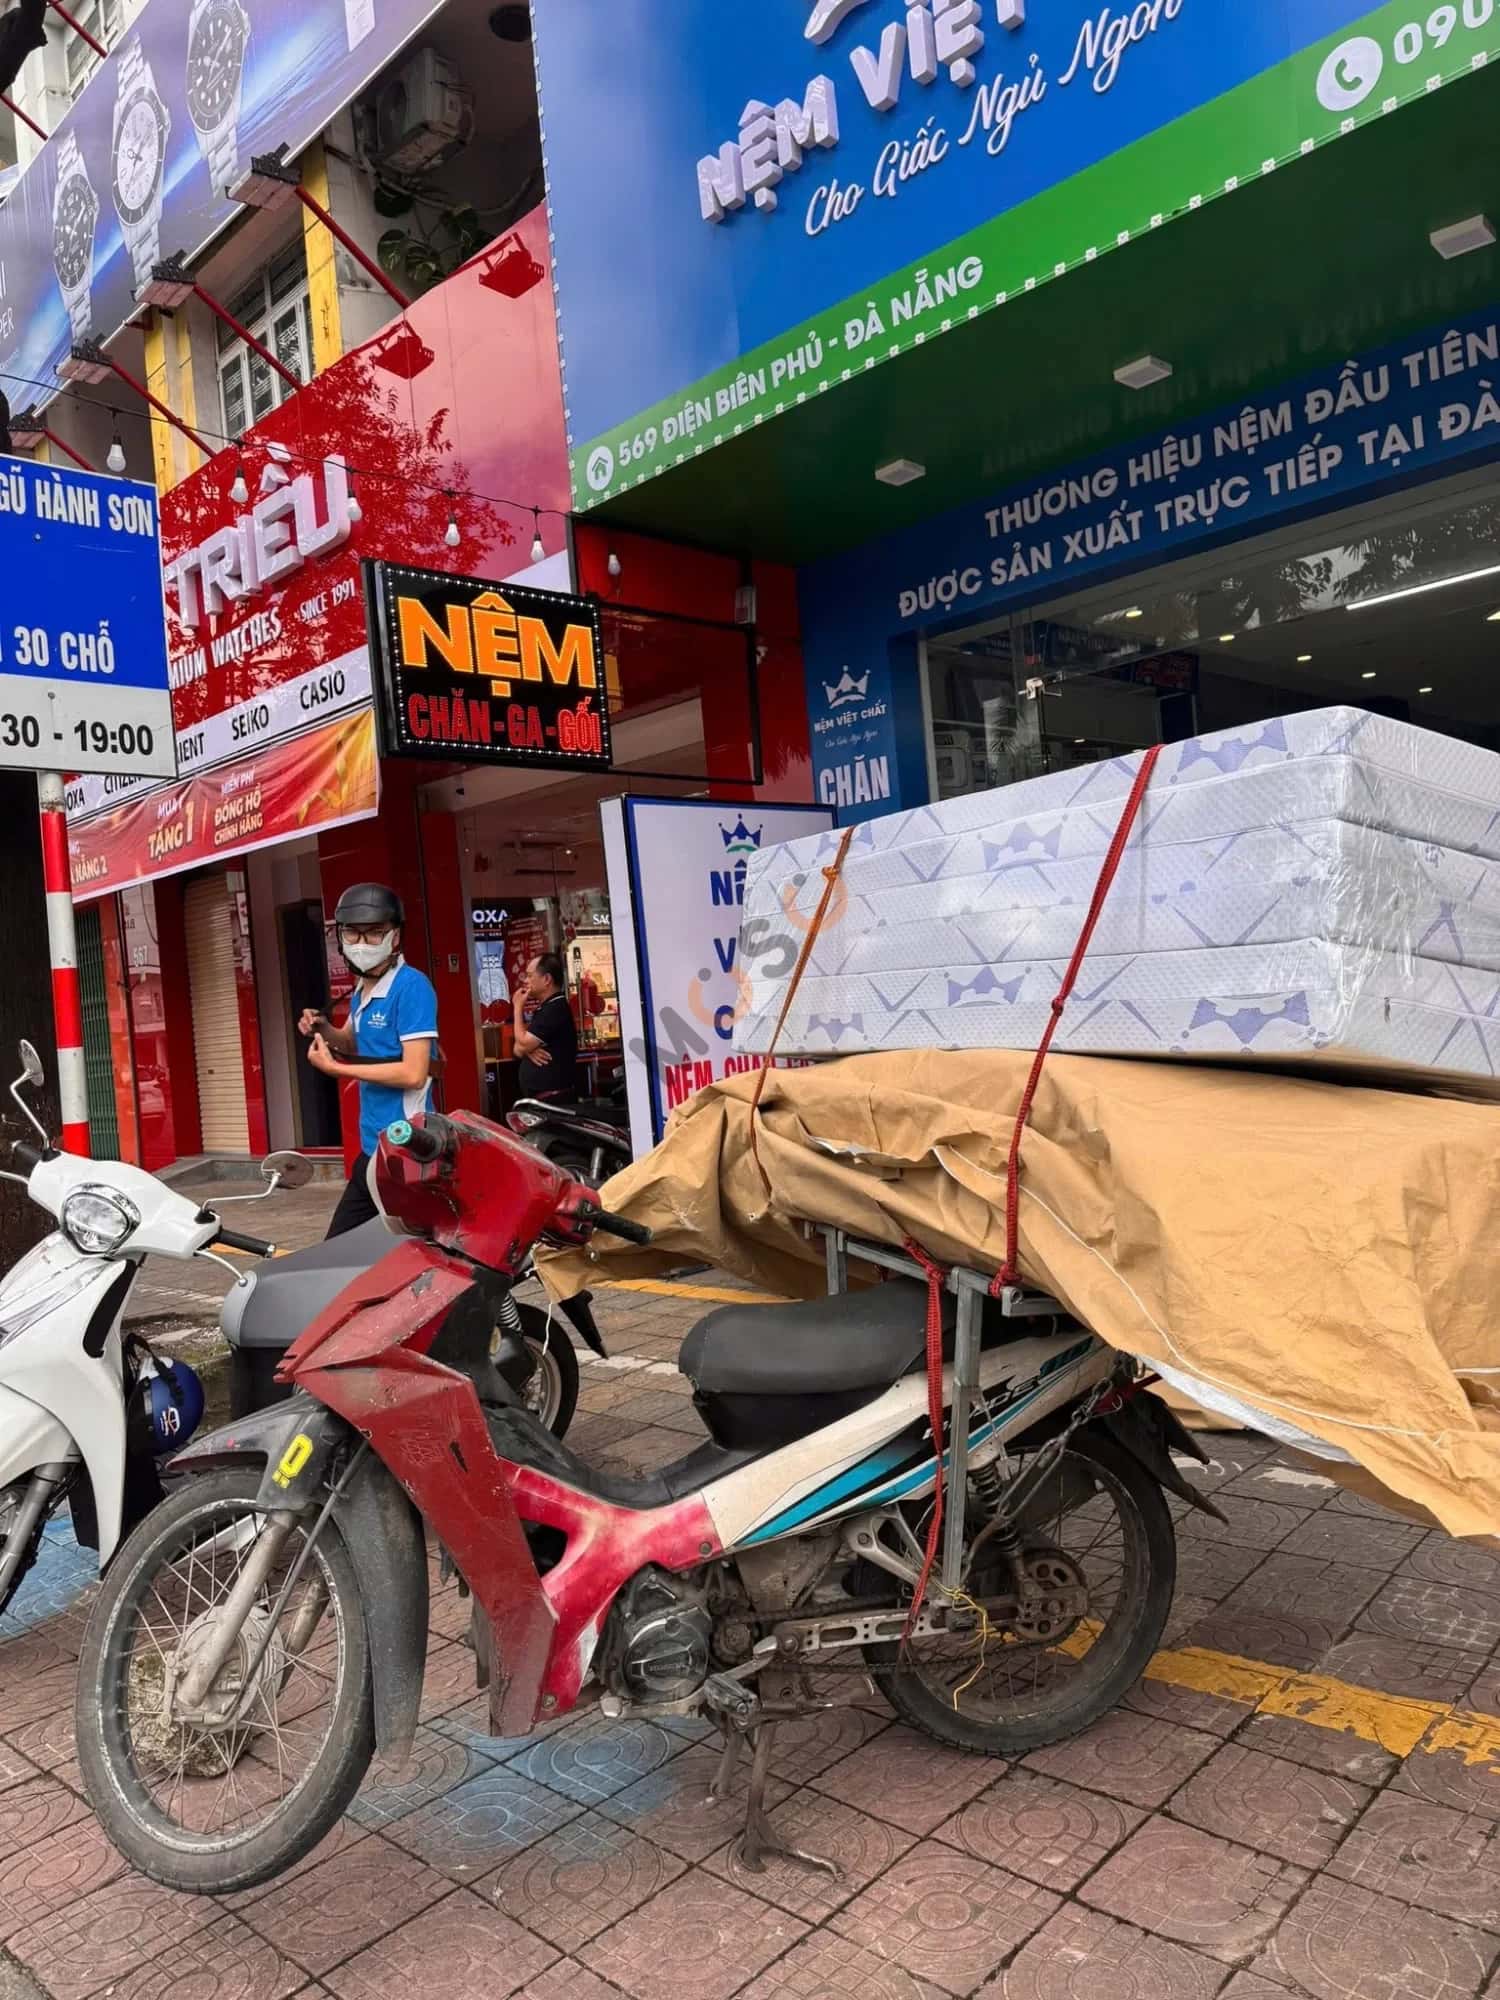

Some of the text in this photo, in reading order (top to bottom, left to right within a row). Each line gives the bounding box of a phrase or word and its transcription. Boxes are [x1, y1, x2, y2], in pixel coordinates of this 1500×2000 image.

[697, 74, 839, 224] NỆM
[805, 178, 864, 236] Cho
[873, 115, 949, 197] Giấc
[957, 53, 1047, 156] Ngủ
[618, 427, 658, 466] 569
[662, 397, 711, 443] ĐIỆN
[715, 368, 767, 417] BIÊN
[770, 331, 823, 388] PHỦ
[844, 302, 885, 349] ĐÀ
[890, 256, 983, 327] NẴNG
[985, 325, 1499, 538] THƯƠNG HIỆU NỆM ĐẦU TIÊN
[35, 471, 101, 528] HÀNH
[108, 493, 154, 537] SƠN
[164, 441, 351, 630] TRIỀU
[899, 379, 1500, 618] ĐƯỢC SẢN XUẤT TRỰC TIẾP TẠI ĐÀ
[14, 620, 115, 674] 30 CHỖ
[211, 606, 282, 668] WATCHES
[300, 591, 328, 622] SINCE
[331, 578, 355, 607] 1991
[397, 591, 597, 697] NỆM
[74, 719, 153, 756] 19:00
[231, 704, 269, 741] SEIKO
[300, 670, 345, 710] CASIO
[820, 754, 890, 807] CHĂN
